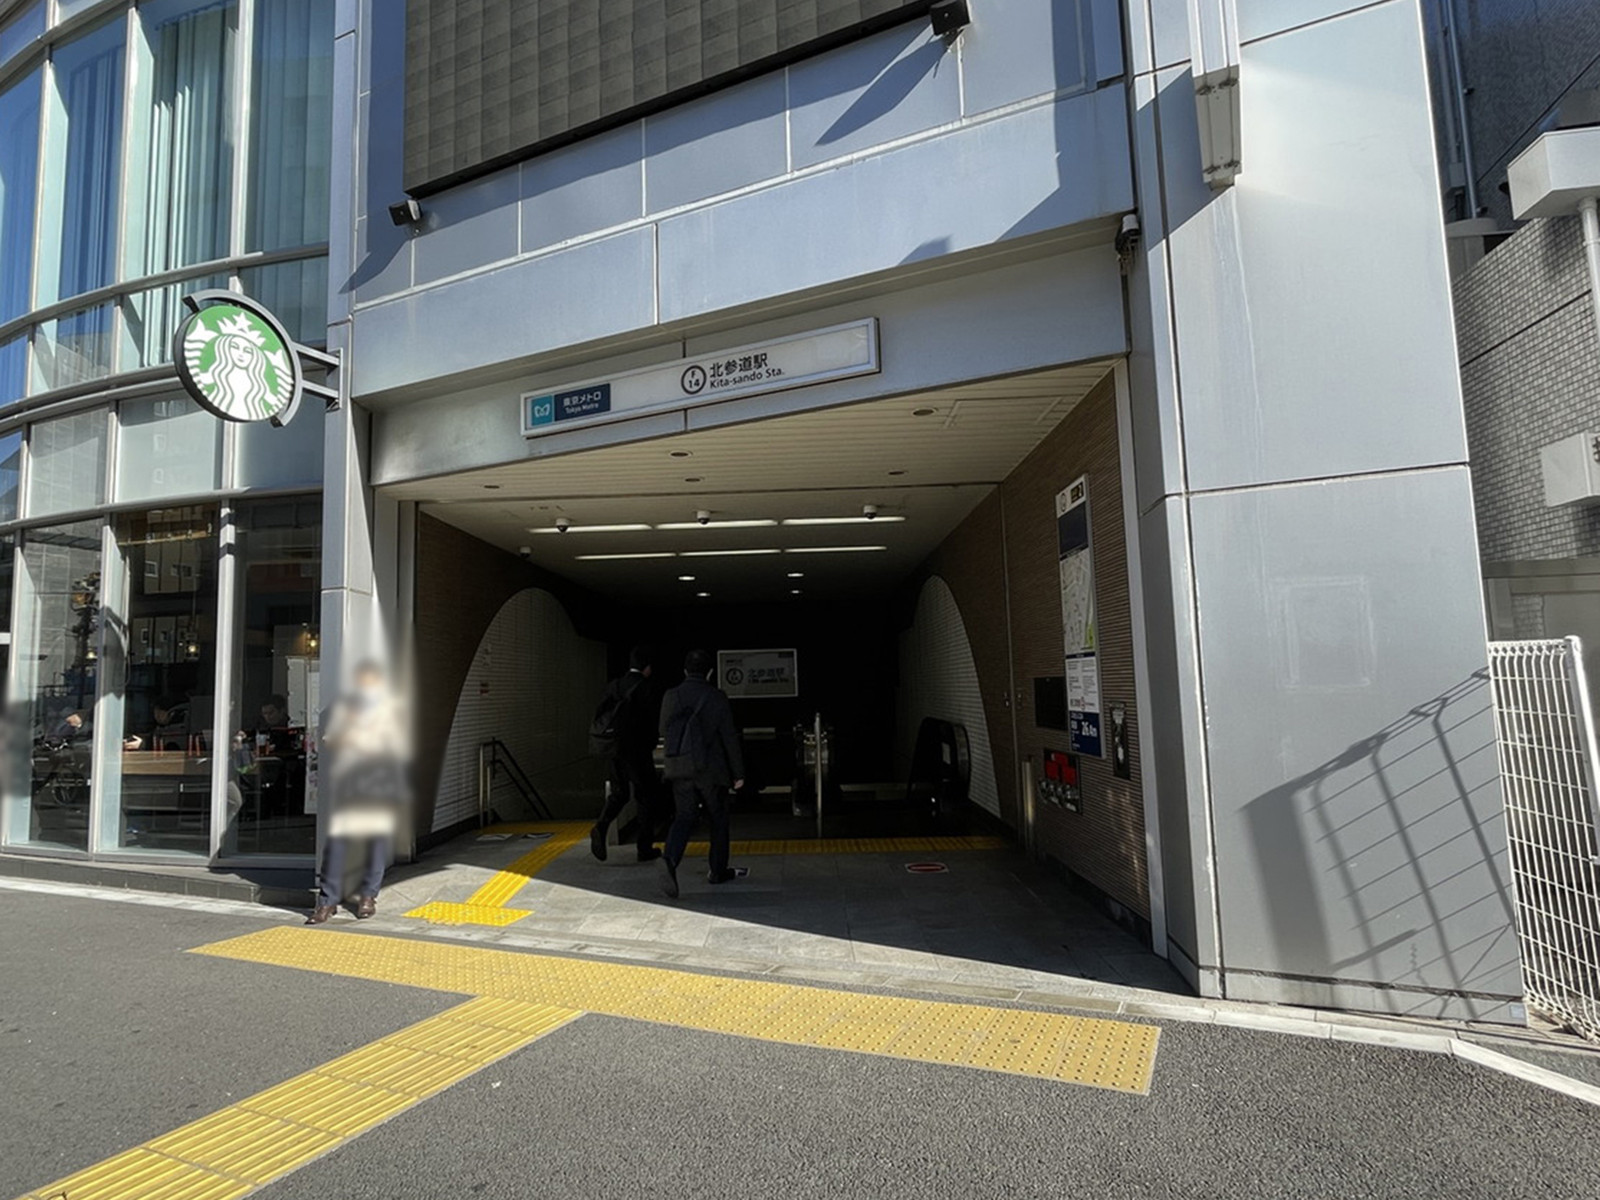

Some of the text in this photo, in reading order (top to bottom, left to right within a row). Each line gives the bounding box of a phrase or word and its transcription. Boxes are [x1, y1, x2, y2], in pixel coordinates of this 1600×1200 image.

[710, 353, 768, 378] 北参道駅
[691, 370, 696, 378] F
[710, 368, 785, 389] Kita-sando Sta.
[689, 379, 700, 388] 14
